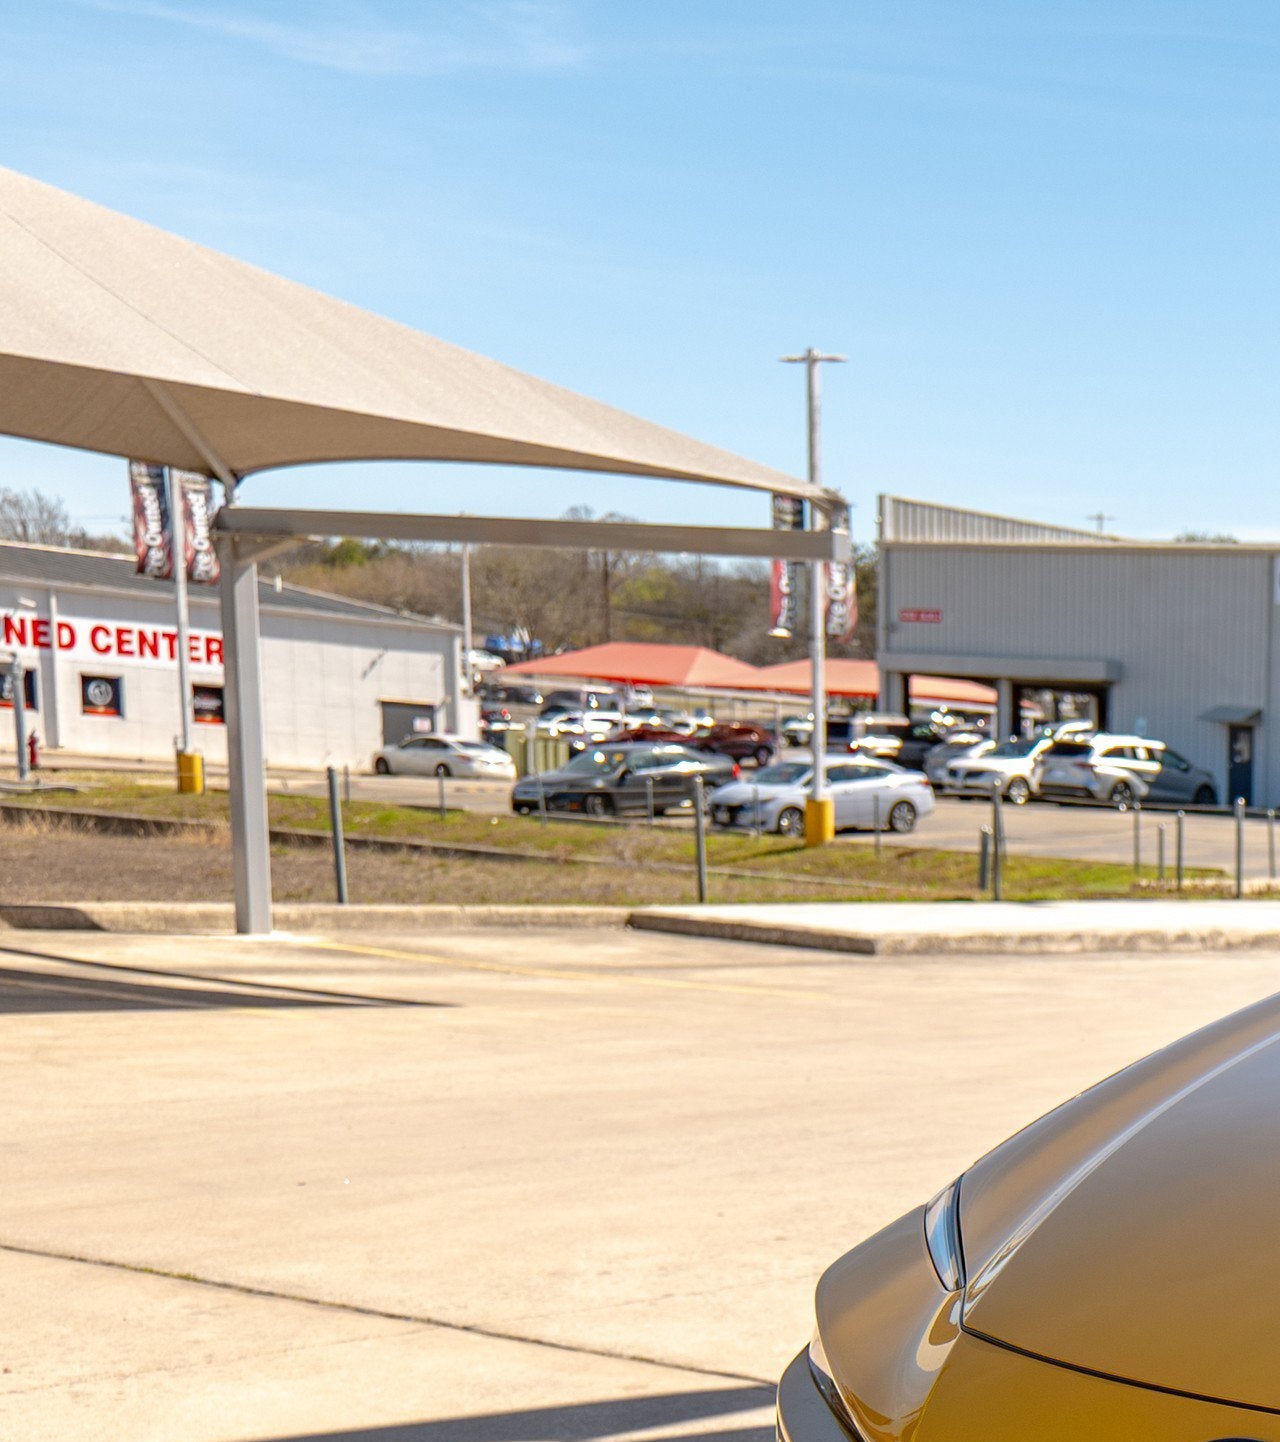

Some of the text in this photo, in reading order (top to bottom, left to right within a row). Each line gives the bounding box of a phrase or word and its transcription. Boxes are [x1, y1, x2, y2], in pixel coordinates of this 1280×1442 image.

[139, 486, 163, 547] Owned
[187, 491, 210, 551] Owned
[143, 547, 164, 577] Pre
[191, 551, 212, 580] Pre
[90, 625, 225, 665] CENTER
